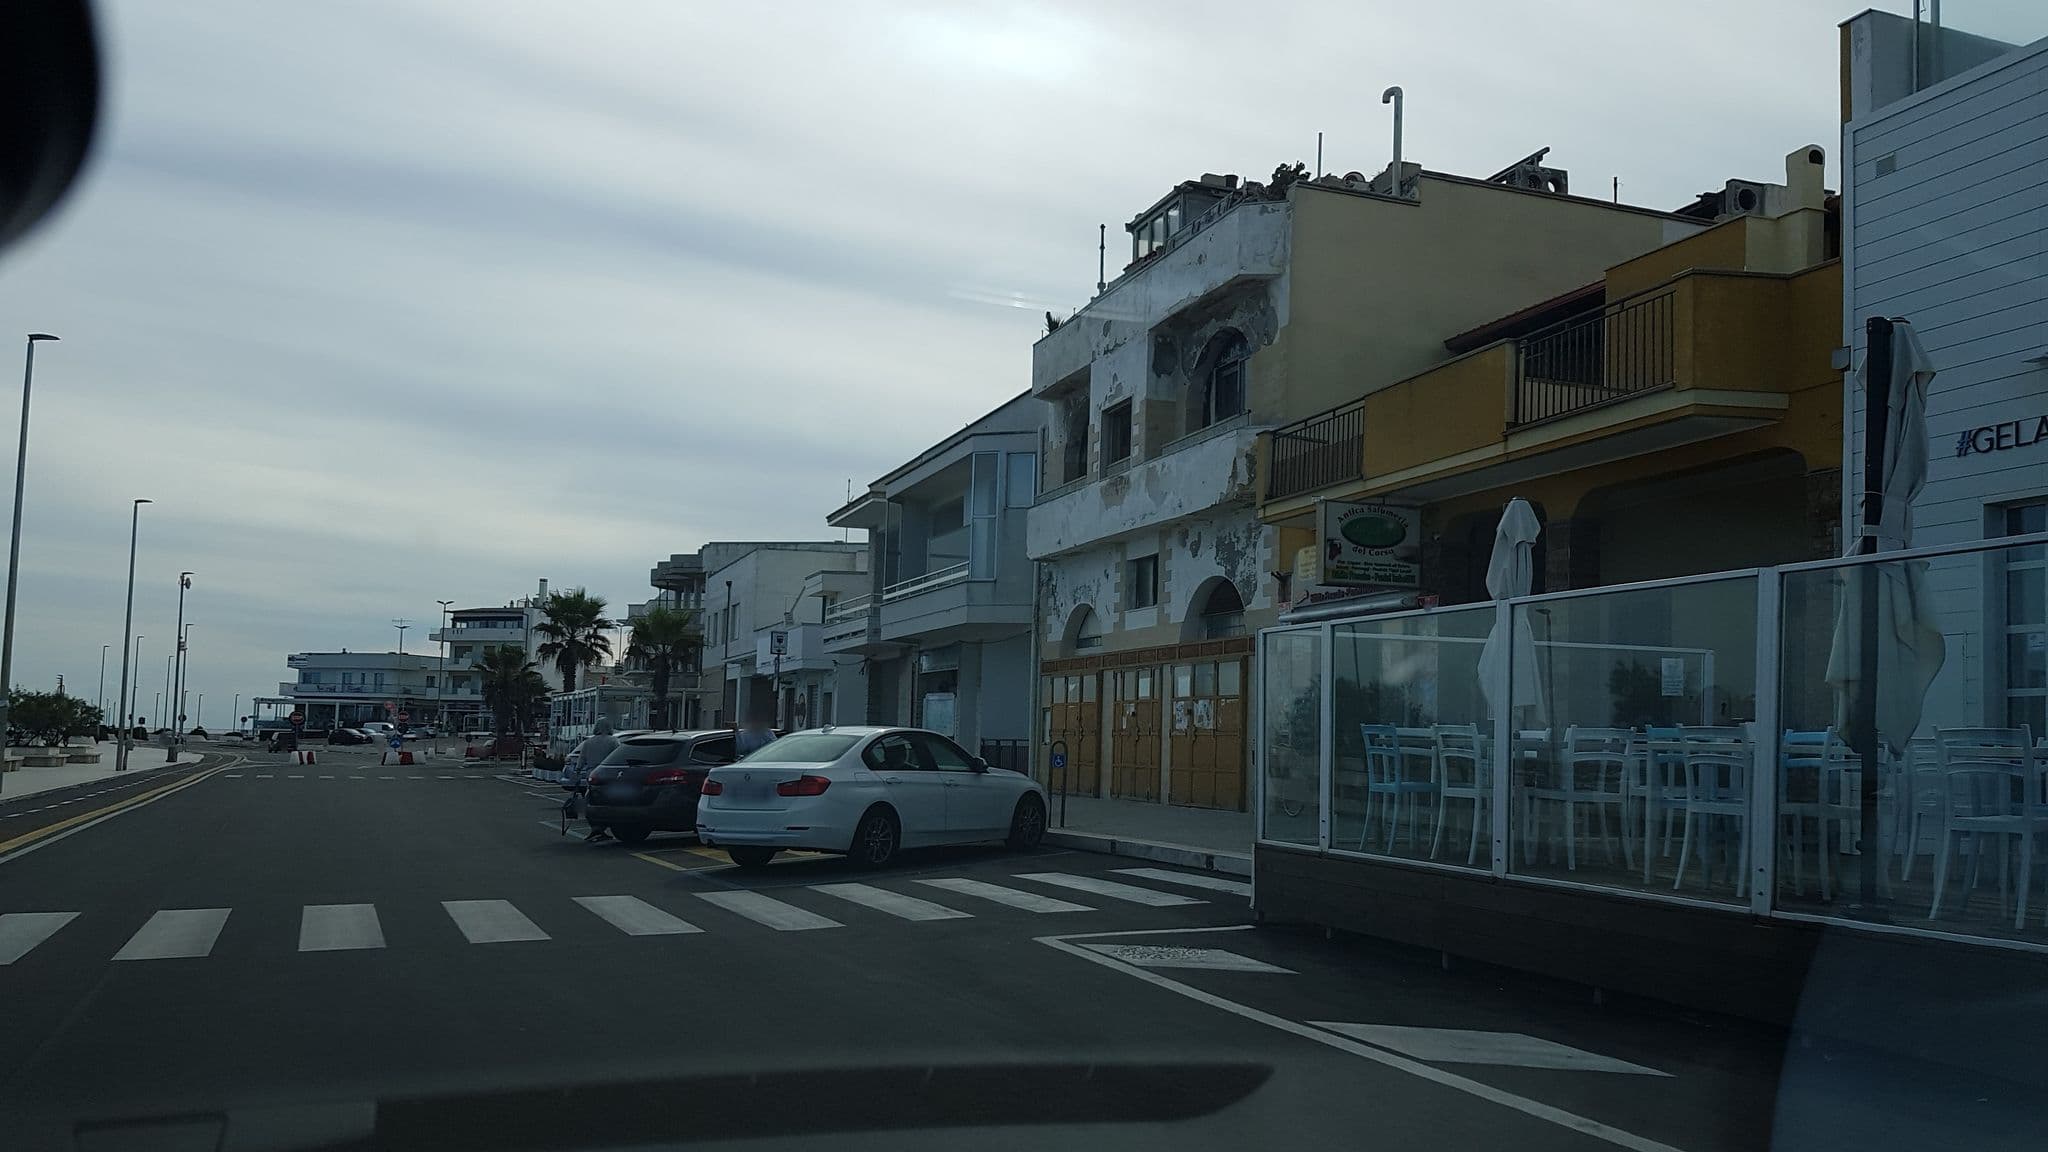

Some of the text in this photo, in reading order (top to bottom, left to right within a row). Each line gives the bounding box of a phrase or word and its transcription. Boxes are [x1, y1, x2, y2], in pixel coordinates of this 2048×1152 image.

[1337, 505, 1408, 528] Antica Salumeria
[1352, 545, 1394, 557] del Corso
